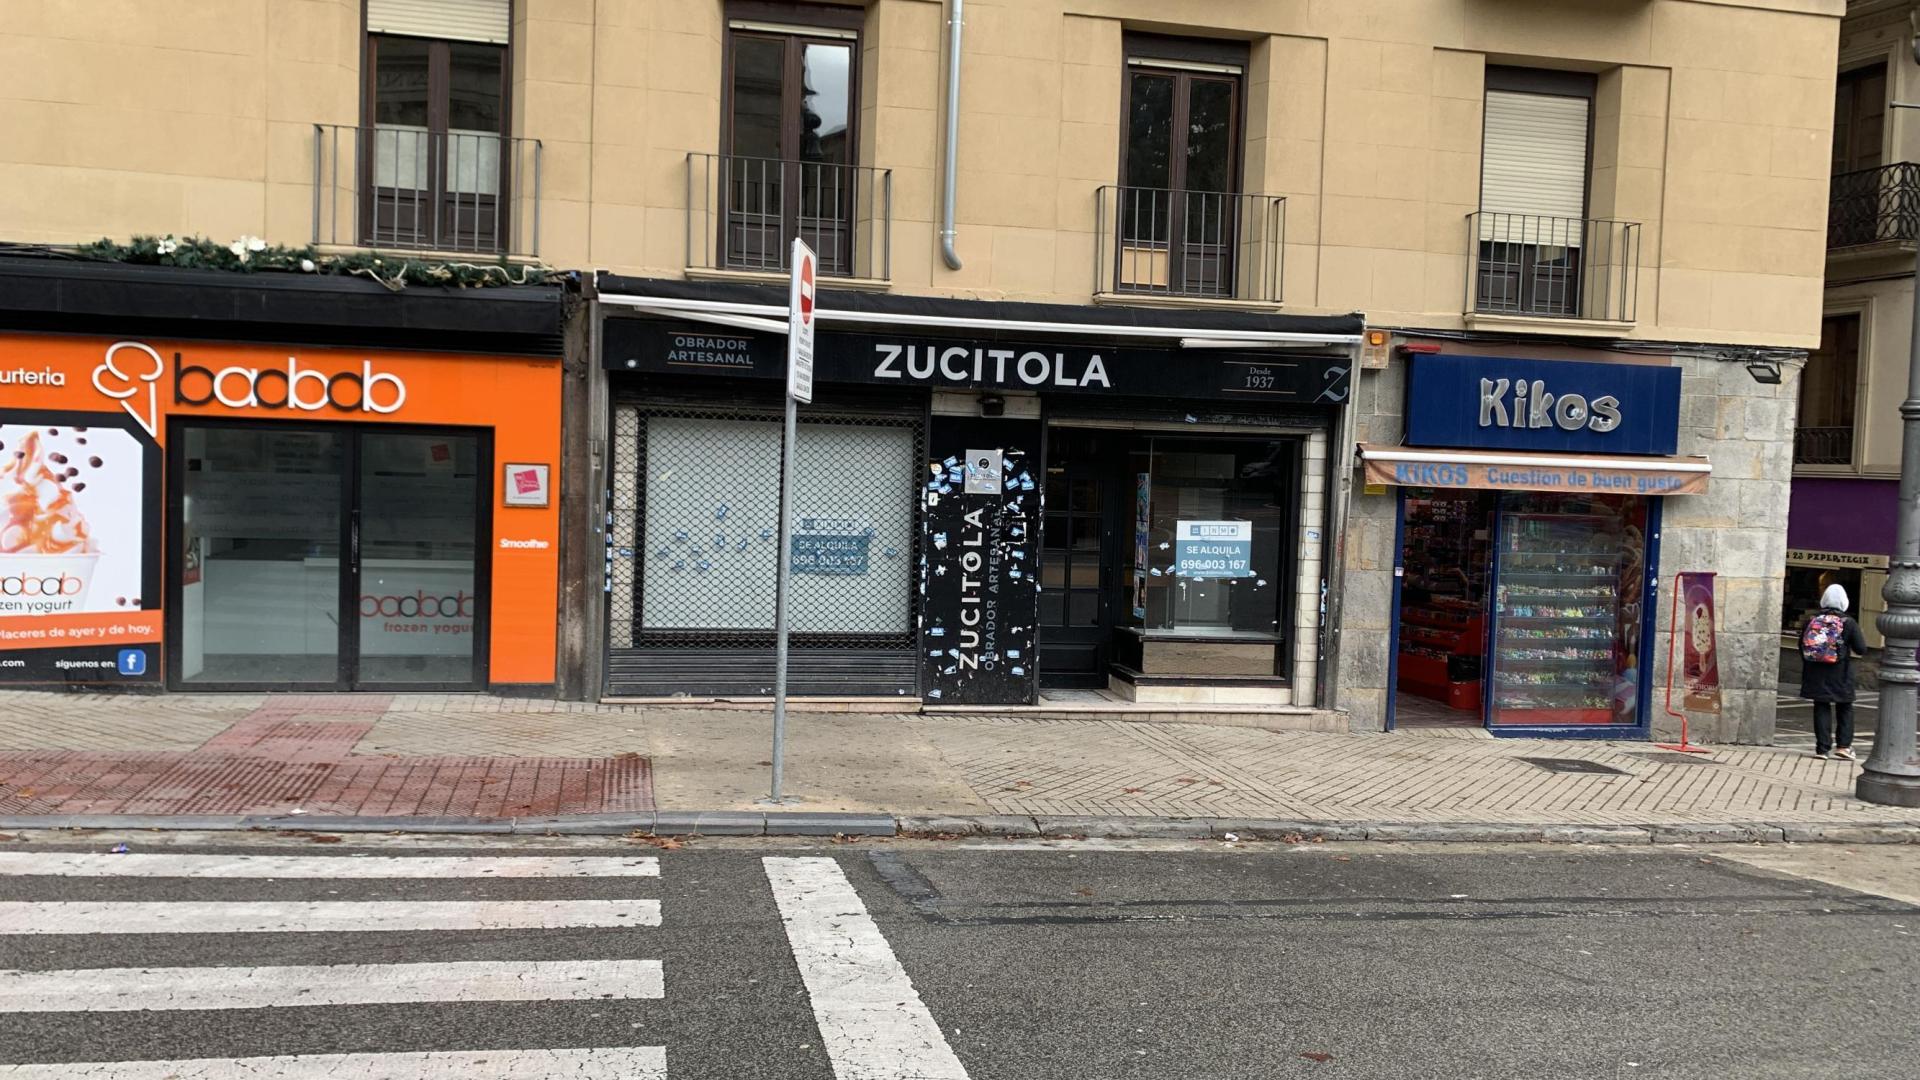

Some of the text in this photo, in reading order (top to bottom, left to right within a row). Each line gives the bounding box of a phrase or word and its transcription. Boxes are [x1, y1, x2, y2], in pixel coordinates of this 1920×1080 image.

[675, 336, 747, 350] OBRADOR
[667, 350, 754, 365] ARTESANAL
[873, 343, 1111, 388] ZUCITOLA
[1249, 366, 1271, 376] Desde
[174, 351, 407, 414] baobab
[1245, 375, 1275, 389] 1937
[1479, 377, 1622, 432] Kikos
[1395, 462, 1469, 486] KIKOS
[1567, 471, 1587, 486] de
[1592, 471, 1632, 488] buen
[1637, 474, 1682, 492] gusto
[1186, 546, 1241, 555] SE ALQUILA
[1181, 559, 1246, 570] 696 003 167
[959, 507, 984, 670] ZUCITOLA
[27, 600, 73, 613] yogurt
[50, 627, 65, 638] de
[68, 626, 95, 639] ayer
[98, 626, 106, 637] y
[109, 624, 125, 635] de
[128, 624, 154, 637] hoy.
[384, 622, 428, 633] frozen
[985, 599, 998, 672] OBRADOR
